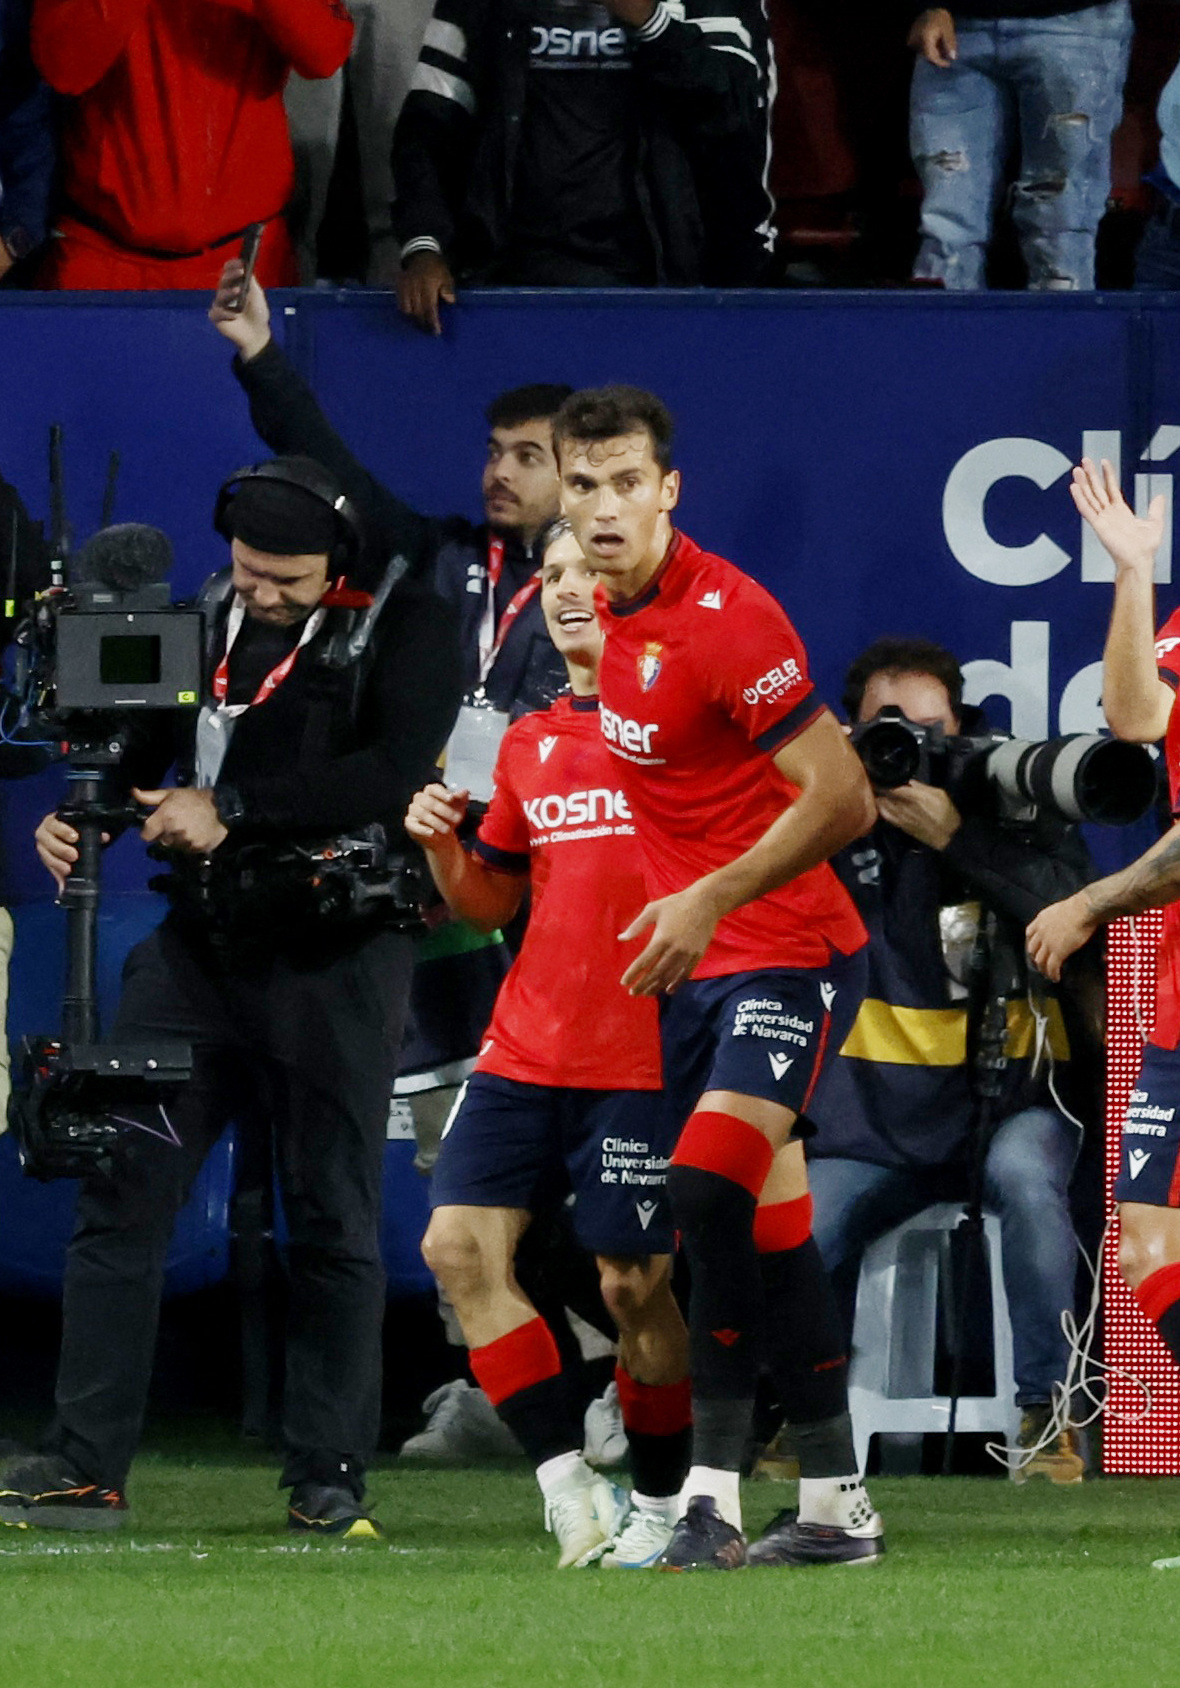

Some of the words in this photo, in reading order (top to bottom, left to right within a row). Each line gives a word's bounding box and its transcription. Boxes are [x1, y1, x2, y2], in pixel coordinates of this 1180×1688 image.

[737, 998, 783, 1013] Clínica
[734, 1011, 814, 1034] Universidad
[751, 1023, 808, 1048] Navarra
[602, 1137, 649, 1153] Clínica
[600, 1168, 618, 1184] de
